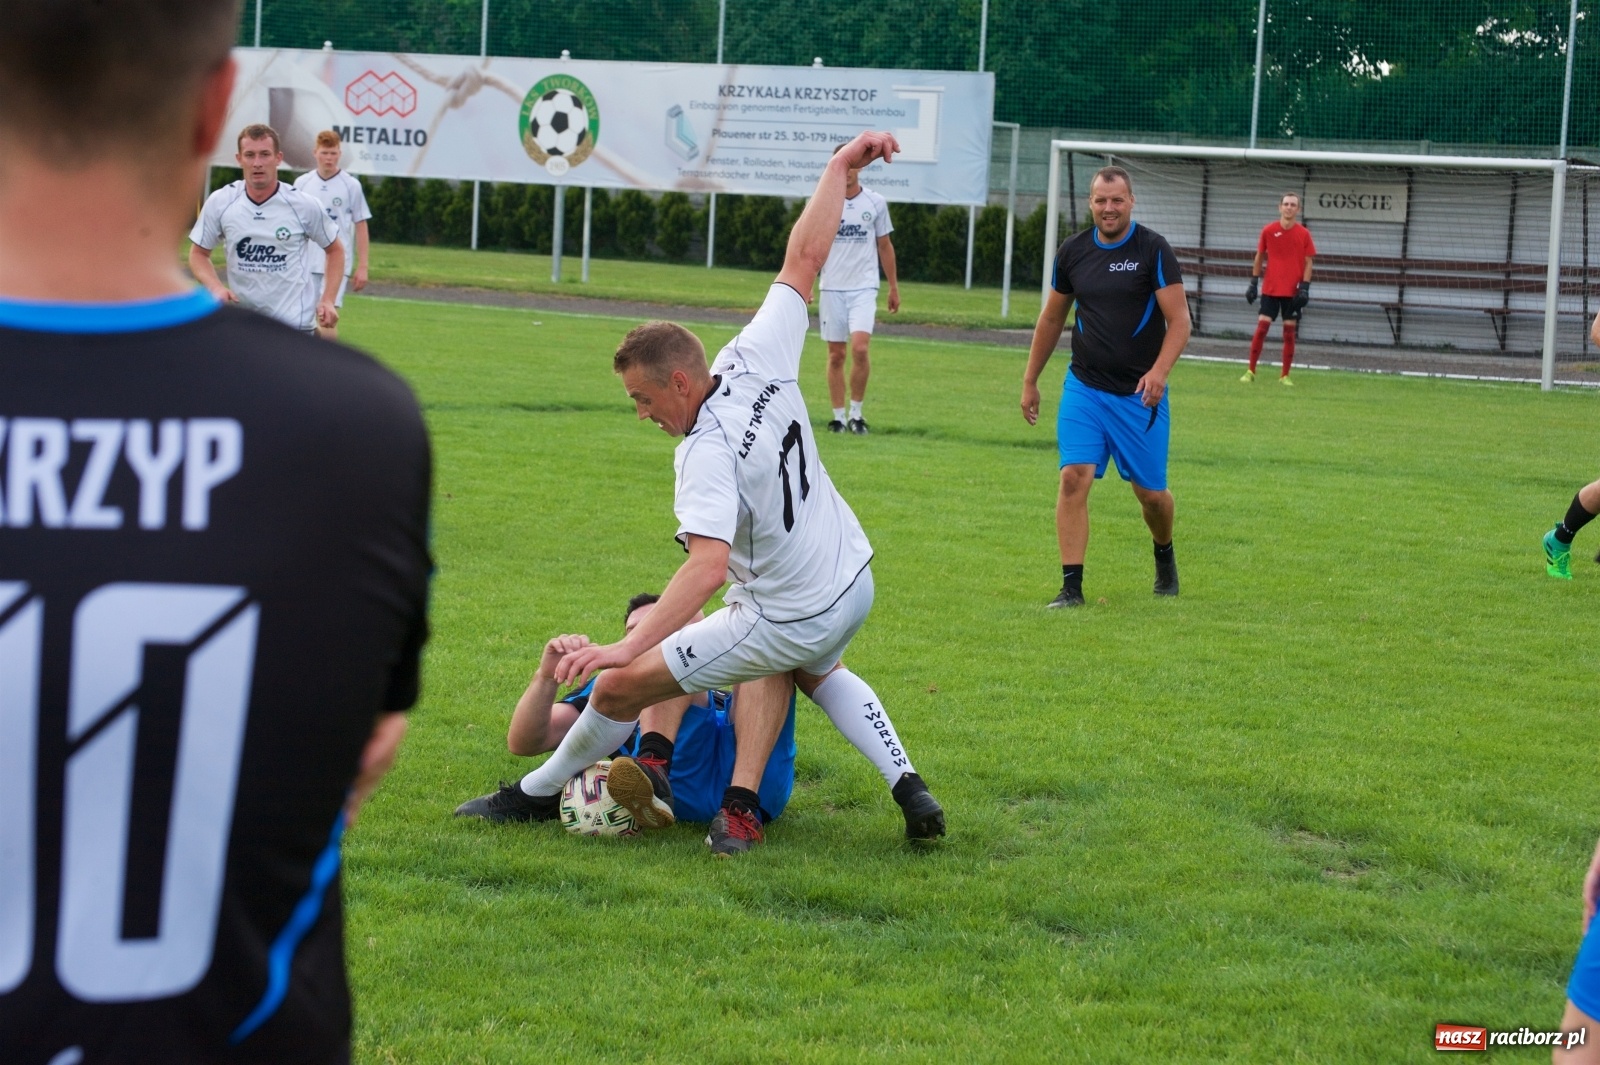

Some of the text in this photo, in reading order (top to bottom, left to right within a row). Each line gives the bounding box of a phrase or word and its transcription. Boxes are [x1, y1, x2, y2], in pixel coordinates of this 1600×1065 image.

[718, 85, 878, 101] KRZYKAŁA KRZYSZTOF
[741, 103, 791, 113] genormten
[851, 106, 906, 117] Trockenbau
[333, 125, 428, 147] METALIO
[712, 129, 756, 139] Plauener
[792, 132, 827, 142] 30-179
[754, 171, 802, 183] Montagen
[244, 254, 287, 263] KANTOR
[1109, 259, 1140, 272] safer
[738, 430, 757, 460] LKS
[0, 418, 243, 529] RZYP
